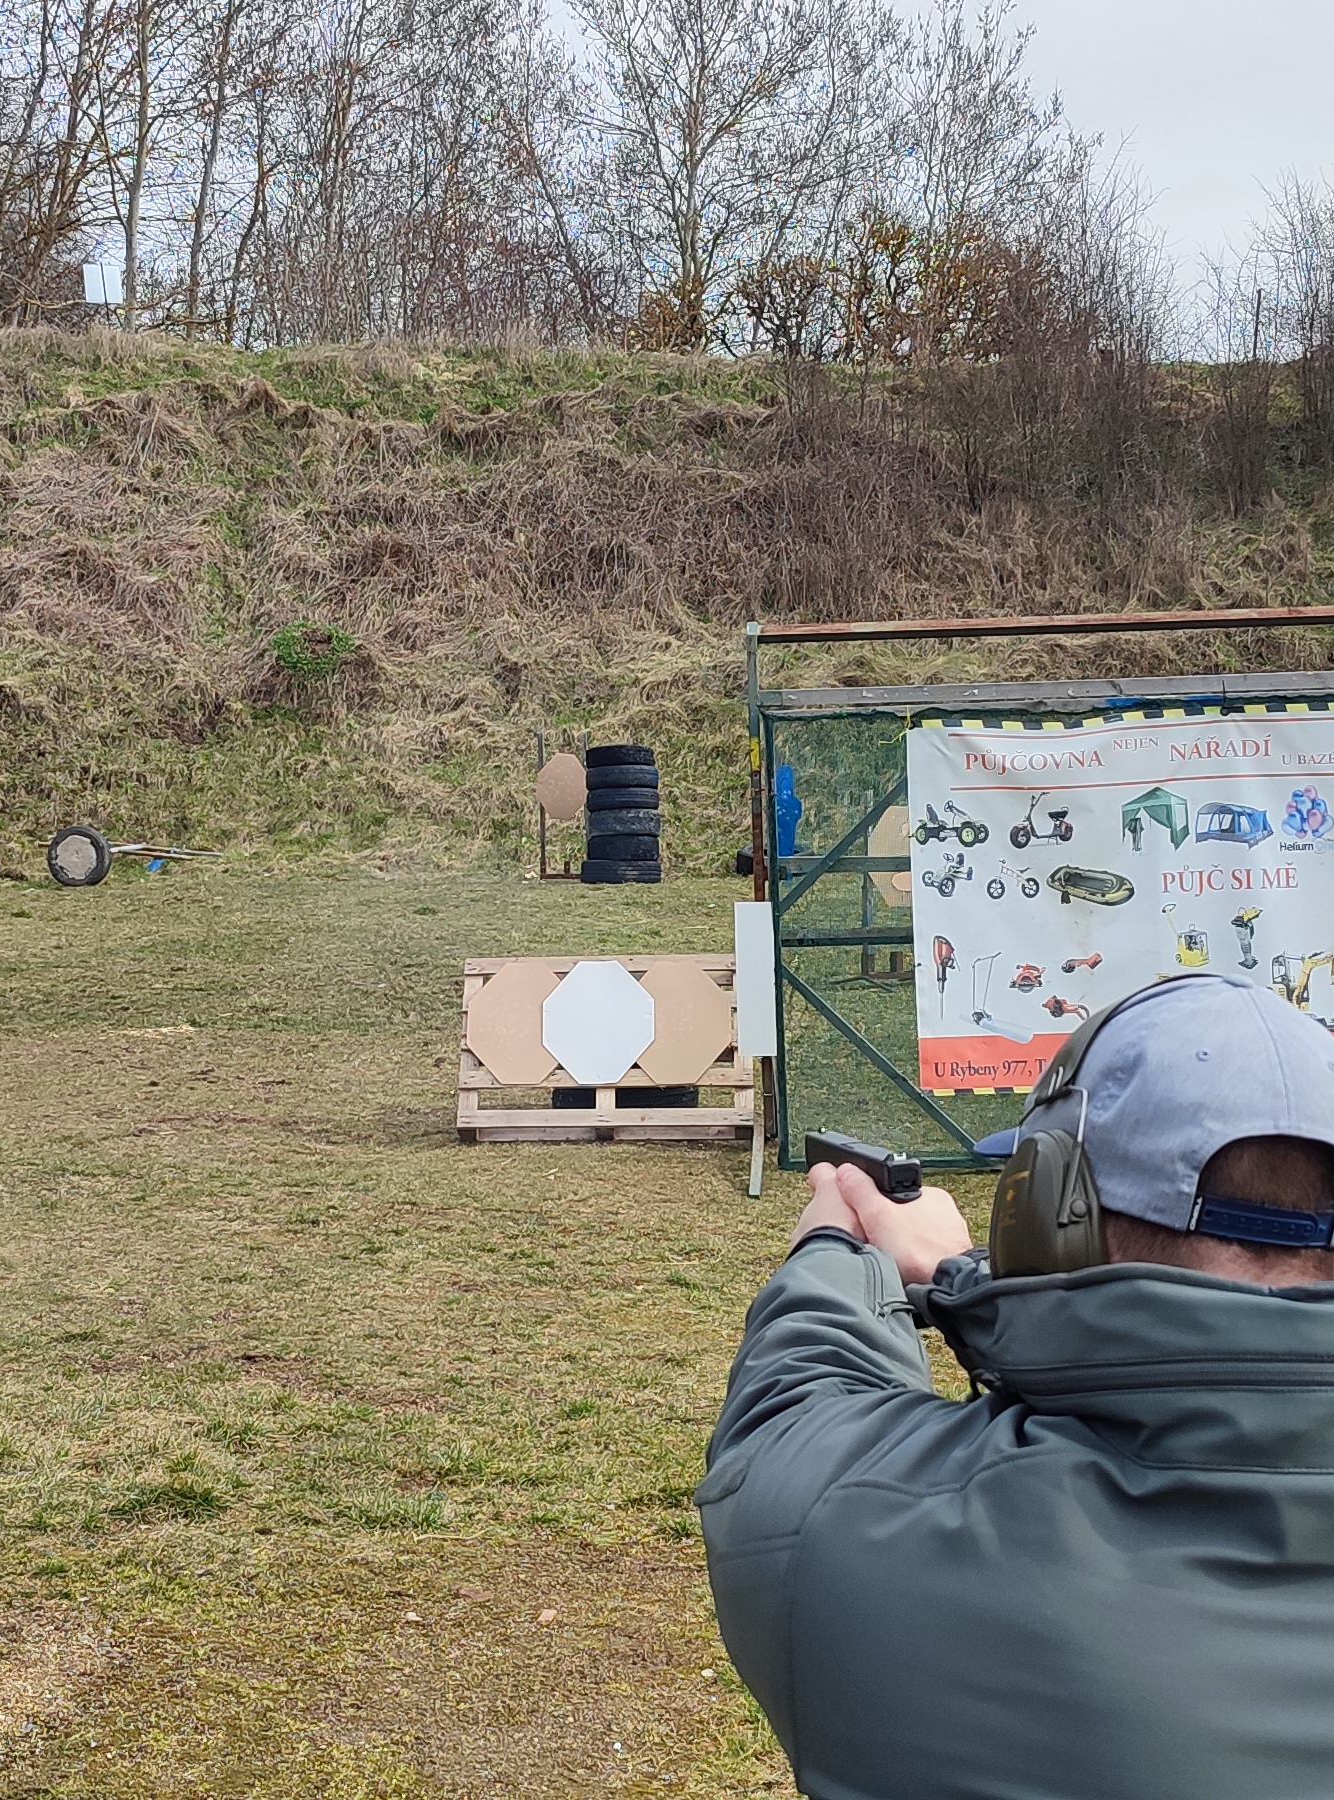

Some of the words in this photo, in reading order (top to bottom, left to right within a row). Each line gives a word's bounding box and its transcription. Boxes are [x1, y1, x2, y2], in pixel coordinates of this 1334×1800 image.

[964, 748, 1105, 775] PŮJČOVNA
[1113, 737, 1160, 751] NEJEN
[1169, 734, 1272, 762] NÁŘADÍ
[1281, 754, 1292, 765] U
[1161, 864, 1224, 897] PŮJČ
[1231, 868, 1253, 890] SI
[1261, 862, 1298, 889] MĚ
[934, 1062, 946, 1078] U
[1002, 1060, 1033, 1077] 977,
